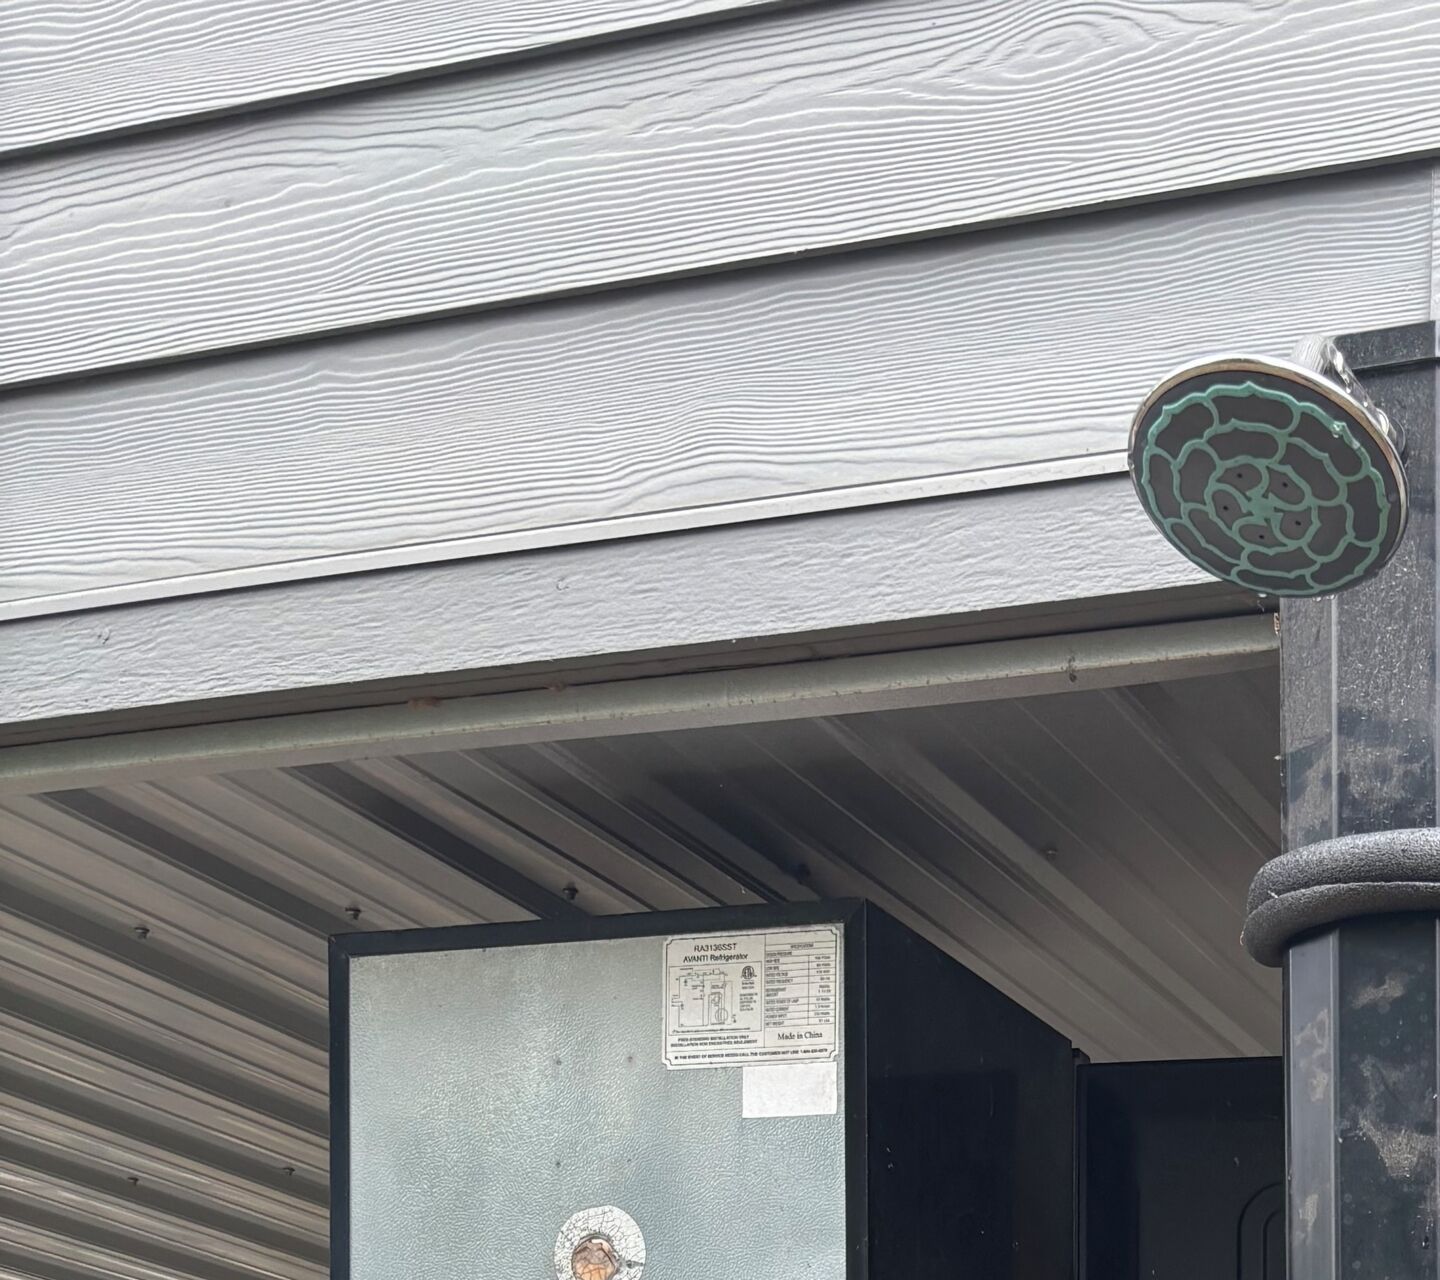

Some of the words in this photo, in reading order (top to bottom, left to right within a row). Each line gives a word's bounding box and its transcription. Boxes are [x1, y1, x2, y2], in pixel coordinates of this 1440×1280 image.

[683, 954, 708, 963] AVANTI
[710, 953, 748, 962] Refrigerator
[778, 1032, 795, 1040] Made
[804, 1031, 822, 1039] China
